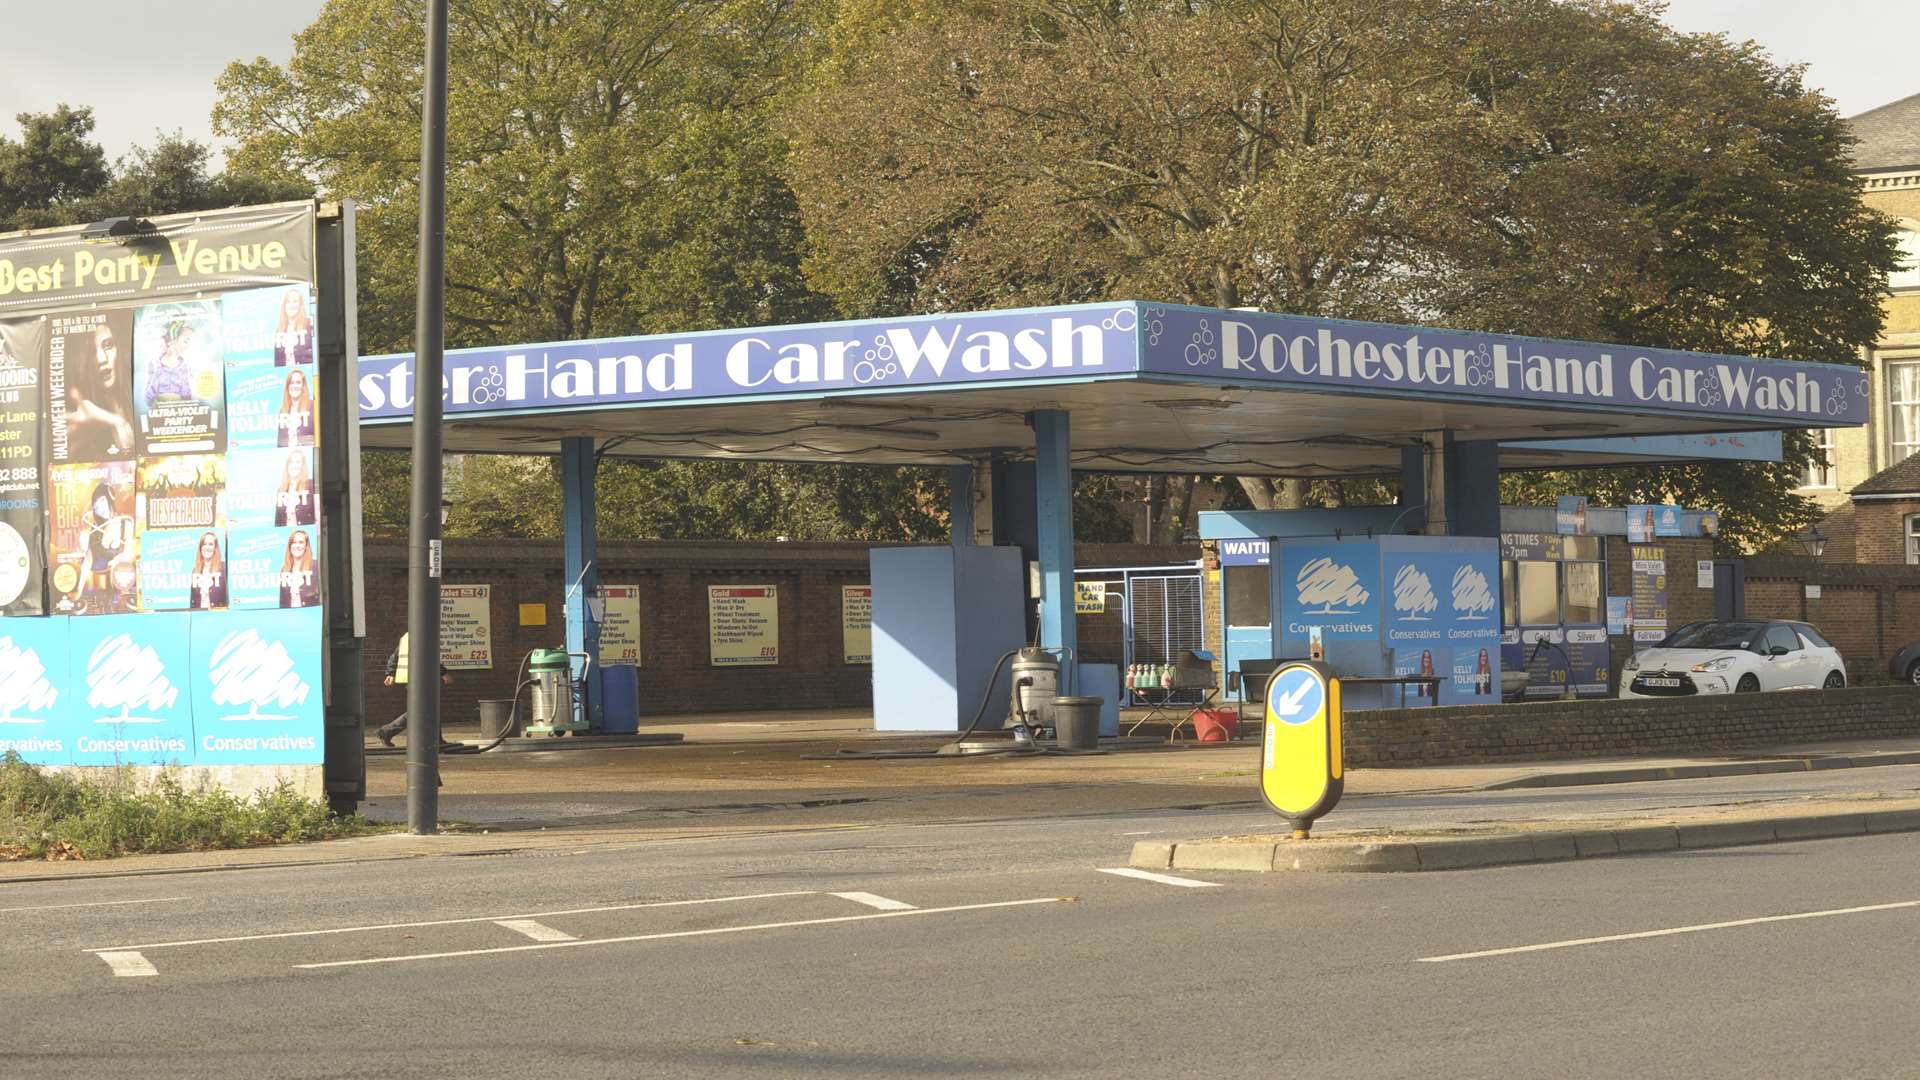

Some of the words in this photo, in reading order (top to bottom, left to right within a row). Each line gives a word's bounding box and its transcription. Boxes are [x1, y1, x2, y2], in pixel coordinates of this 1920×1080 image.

[0, 258, 64, 295] Best
[74, 250, 161, 290] Party
[171, 239, 287, 277] Venue
[506, 343, 693, 401] Hand
[726, 338, 860, 388] Car
[886, 318, 1104, 379] Wash
[50, 336, 66, 399] WEEKENDER
[1221, 320, 1475, 387] Rochester
[1493, 344, 1613, 397] Hand
[1630, 357, 1703, 402] Car
[1716, 364, 1821, 413] Wash
[227, 400, 270, 416] KELLY
[7, 412, 36, 423] Lane
[164, 416, 194, 426] PARTY
[11, 467, 37, 480] 888
[57, 505, 79, 528] BIG
[151, 498, 213, 525] DESPERADOS
[1514, 534, 1539, 546] TIMES
[1510, 546, 1528, 560] 7pm
[1633, 546, 1665, 560] VALET
[143, 560, 183, 574] KELLY
[229, 558, 271, 574] KELLY
[712, 589, 730, 598] Gold
[1077, 584, 1104, 592] HAND
[1081, 592, 1099, 601] CAR
[1077, 603, 1103, 611] WASH
[1389, 628, 1441, 640] Conservatives
[1448, 626, 1498, 639] Conservatives
[1577, 631, 1596, 642] Silver
[469, 650, 488, 660] £25
[760, 646, 776, 656] £10
[1395, 666, 1415, 676] KELLY
[1453, 664, 1473, 674] KELLY
[1454, 673, 1490, 685] TOLHURST
[1551, 670, 1566, 684] £10
[1595, 668, 1608, 681] £6
[77, 735, 186, 753] Conservatives
[203, 733, 316, 752] Conservatives
